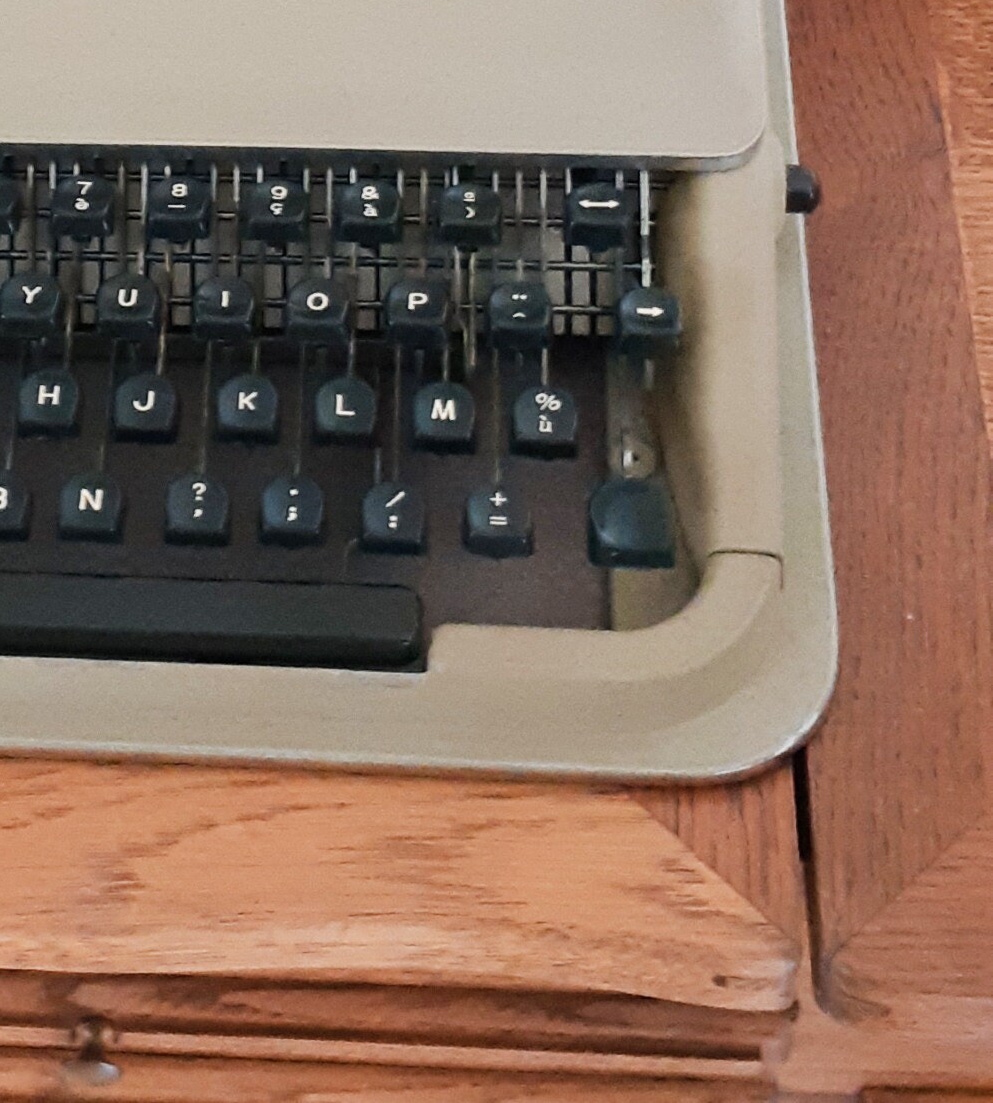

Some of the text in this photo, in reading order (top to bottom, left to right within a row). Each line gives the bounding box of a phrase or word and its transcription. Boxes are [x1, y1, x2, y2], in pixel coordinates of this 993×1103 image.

[77, 180, 93, 195] 7
[171, 183, 188, 197] 8
[270, 185, 288, 200] 9
[21, 285, 43, 304] Y
[117, 288, 138, 307] U
[306, 292, 329, 311] O
[407, 292, 429, 310] P
[37, 384, 61, 405] H
[132, 390, 156, 412] J
[238, 391, 258, 411] K
[335, 394, 356, 416] L
[430, 398, 456, 421] M
[535, 392, 562, 411] %
[78, 488, 104, 511] N
[192, 482, 207, 501] ?
[489, 492, 507, 507] +
[489, 516, 508, 526] =
